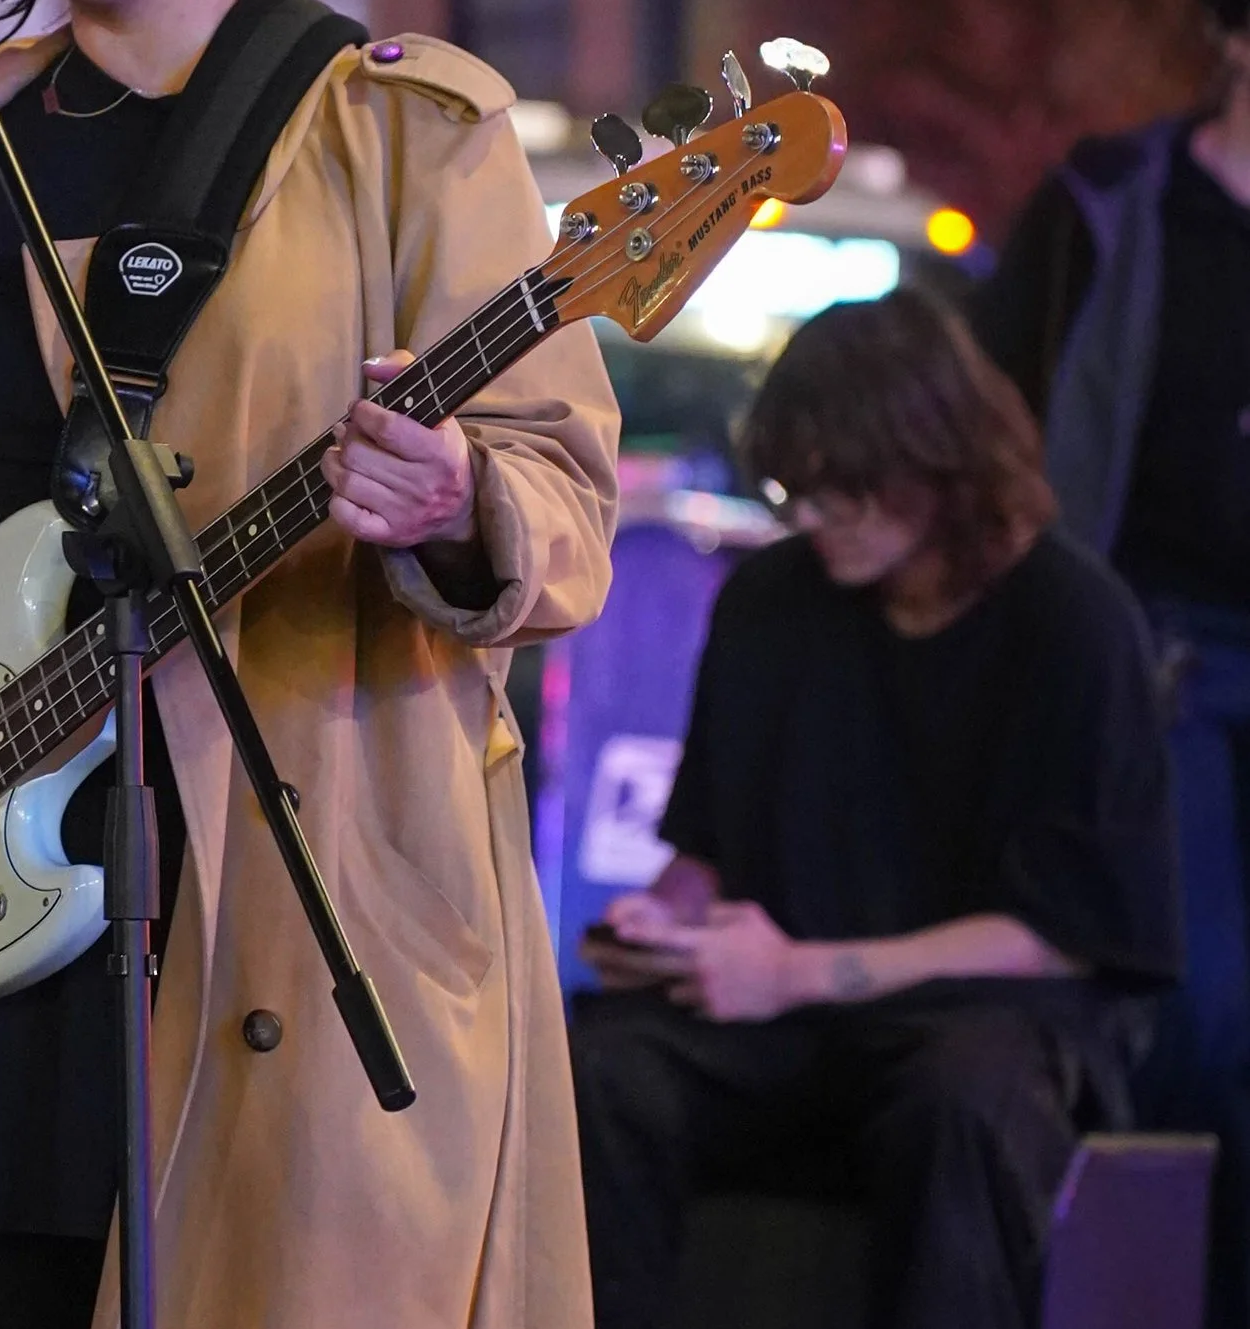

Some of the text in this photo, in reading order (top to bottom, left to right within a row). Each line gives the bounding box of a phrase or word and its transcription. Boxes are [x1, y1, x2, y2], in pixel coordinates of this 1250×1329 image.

[688, 166, 772, 251] MUSTANG BASS
[127, 256, 173, 271] LEKATO
